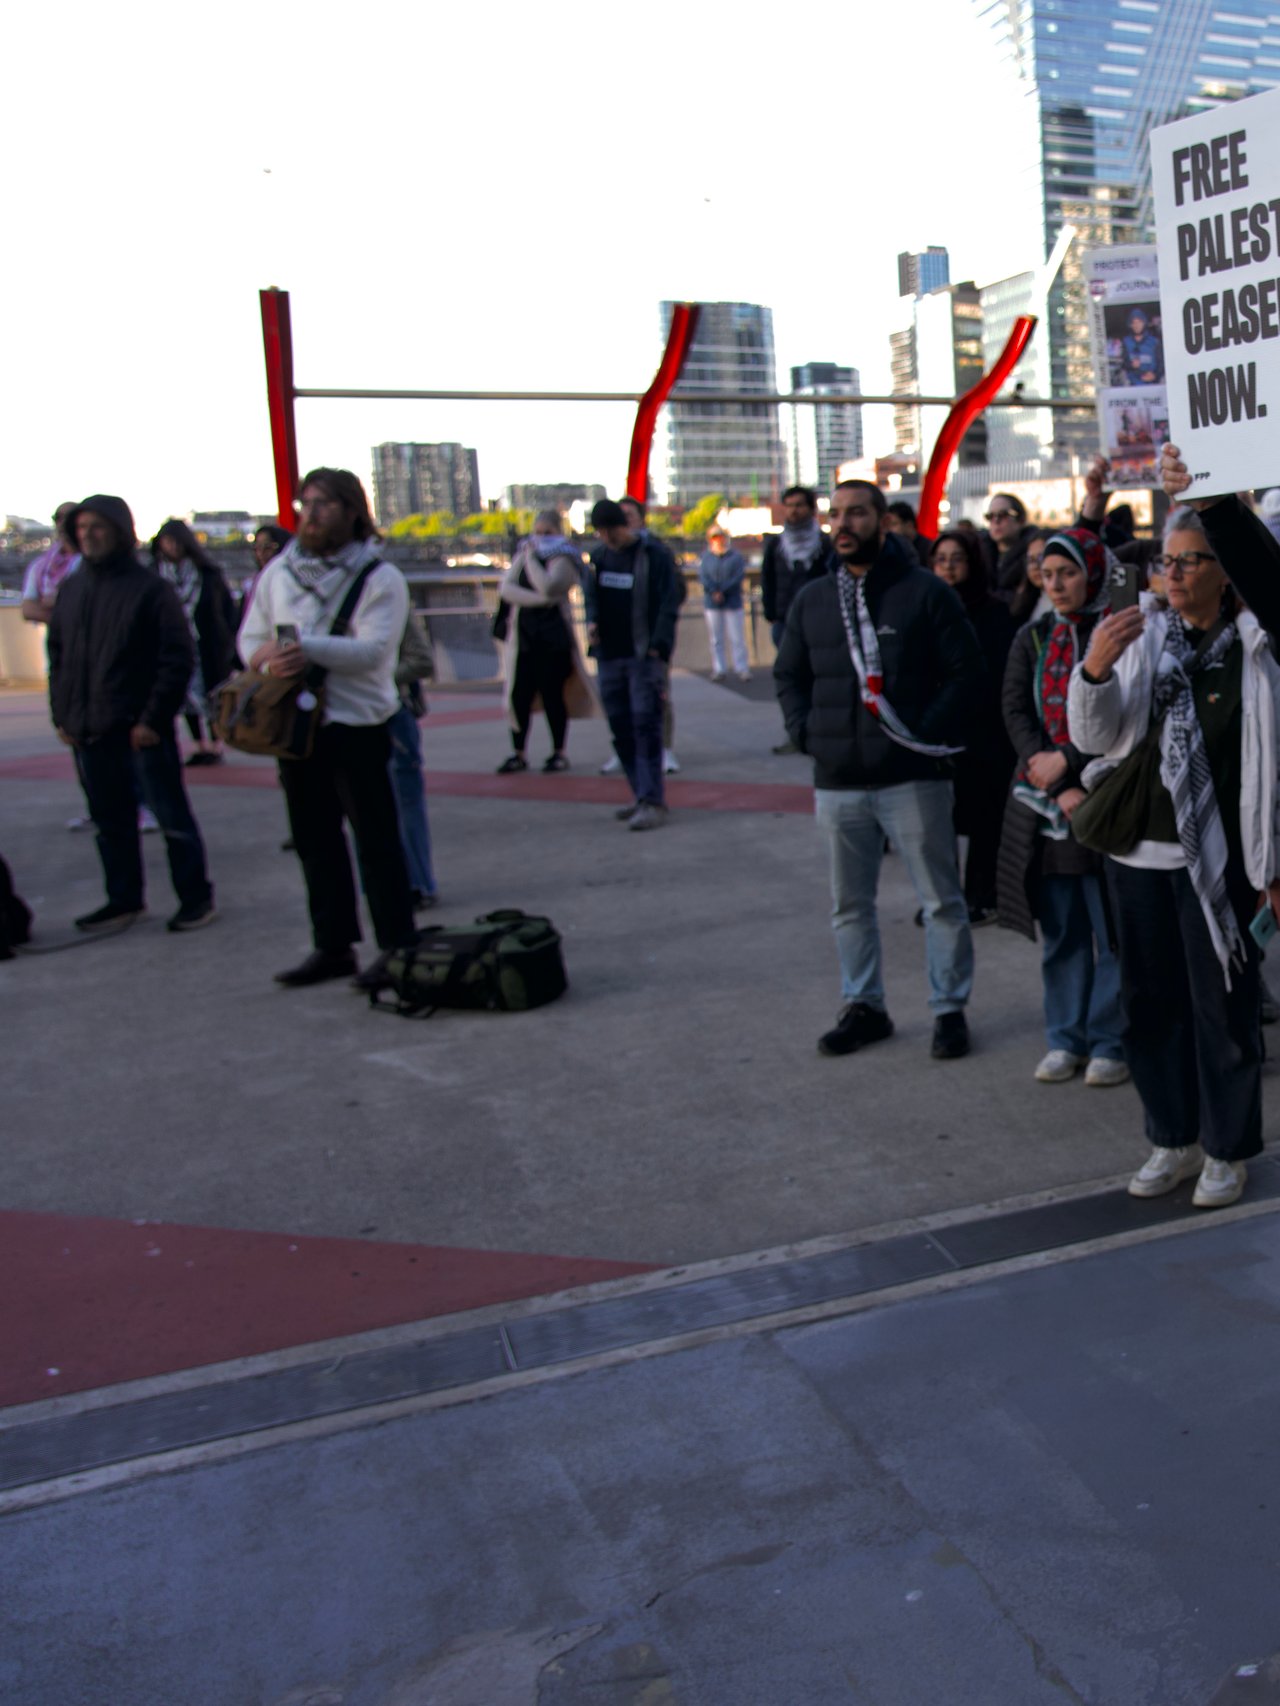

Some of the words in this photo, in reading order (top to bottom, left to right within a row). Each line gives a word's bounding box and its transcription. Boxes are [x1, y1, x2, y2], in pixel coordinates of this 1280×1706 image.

[1172, 129, 1249, 206] FREE
[1093, 257, 1140, 272] PROTECT
[1108, 398, 1138, 408] FROM
[1142, 397, 1162, 407] THE
[1187, 362, 1268, 430] NOW.
[1194, 472, 1211, 481] FPP
